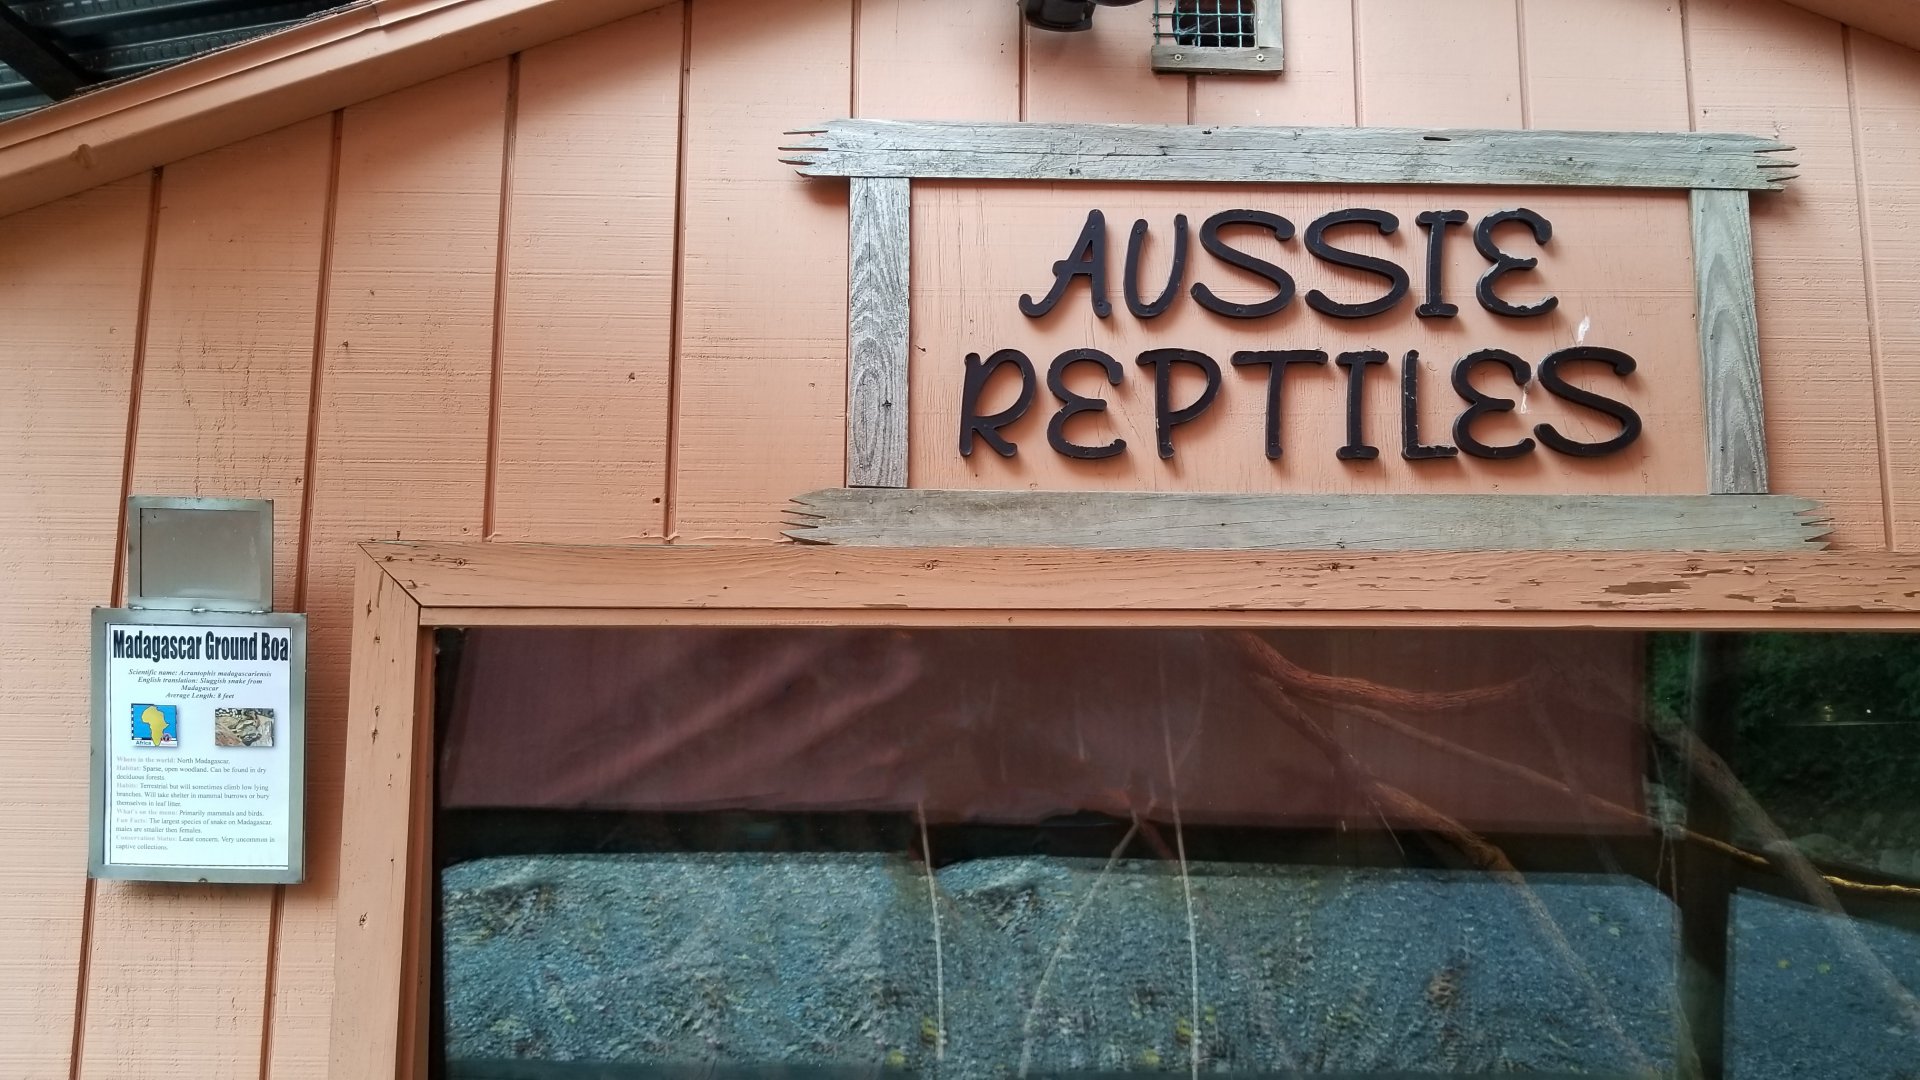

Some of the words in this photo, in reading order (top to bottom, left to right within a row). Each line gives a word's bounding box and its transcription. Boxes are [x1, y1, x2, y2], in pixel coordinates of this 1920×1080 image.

[1018, 207, 1559, 320] AUSSIE
[959, 346, 1643, 461] REPTILES
[113, 630, 202, 662] Madagascar
[206, 631, 257, 660] Ground
[262, 632, 288, 661] Boa
